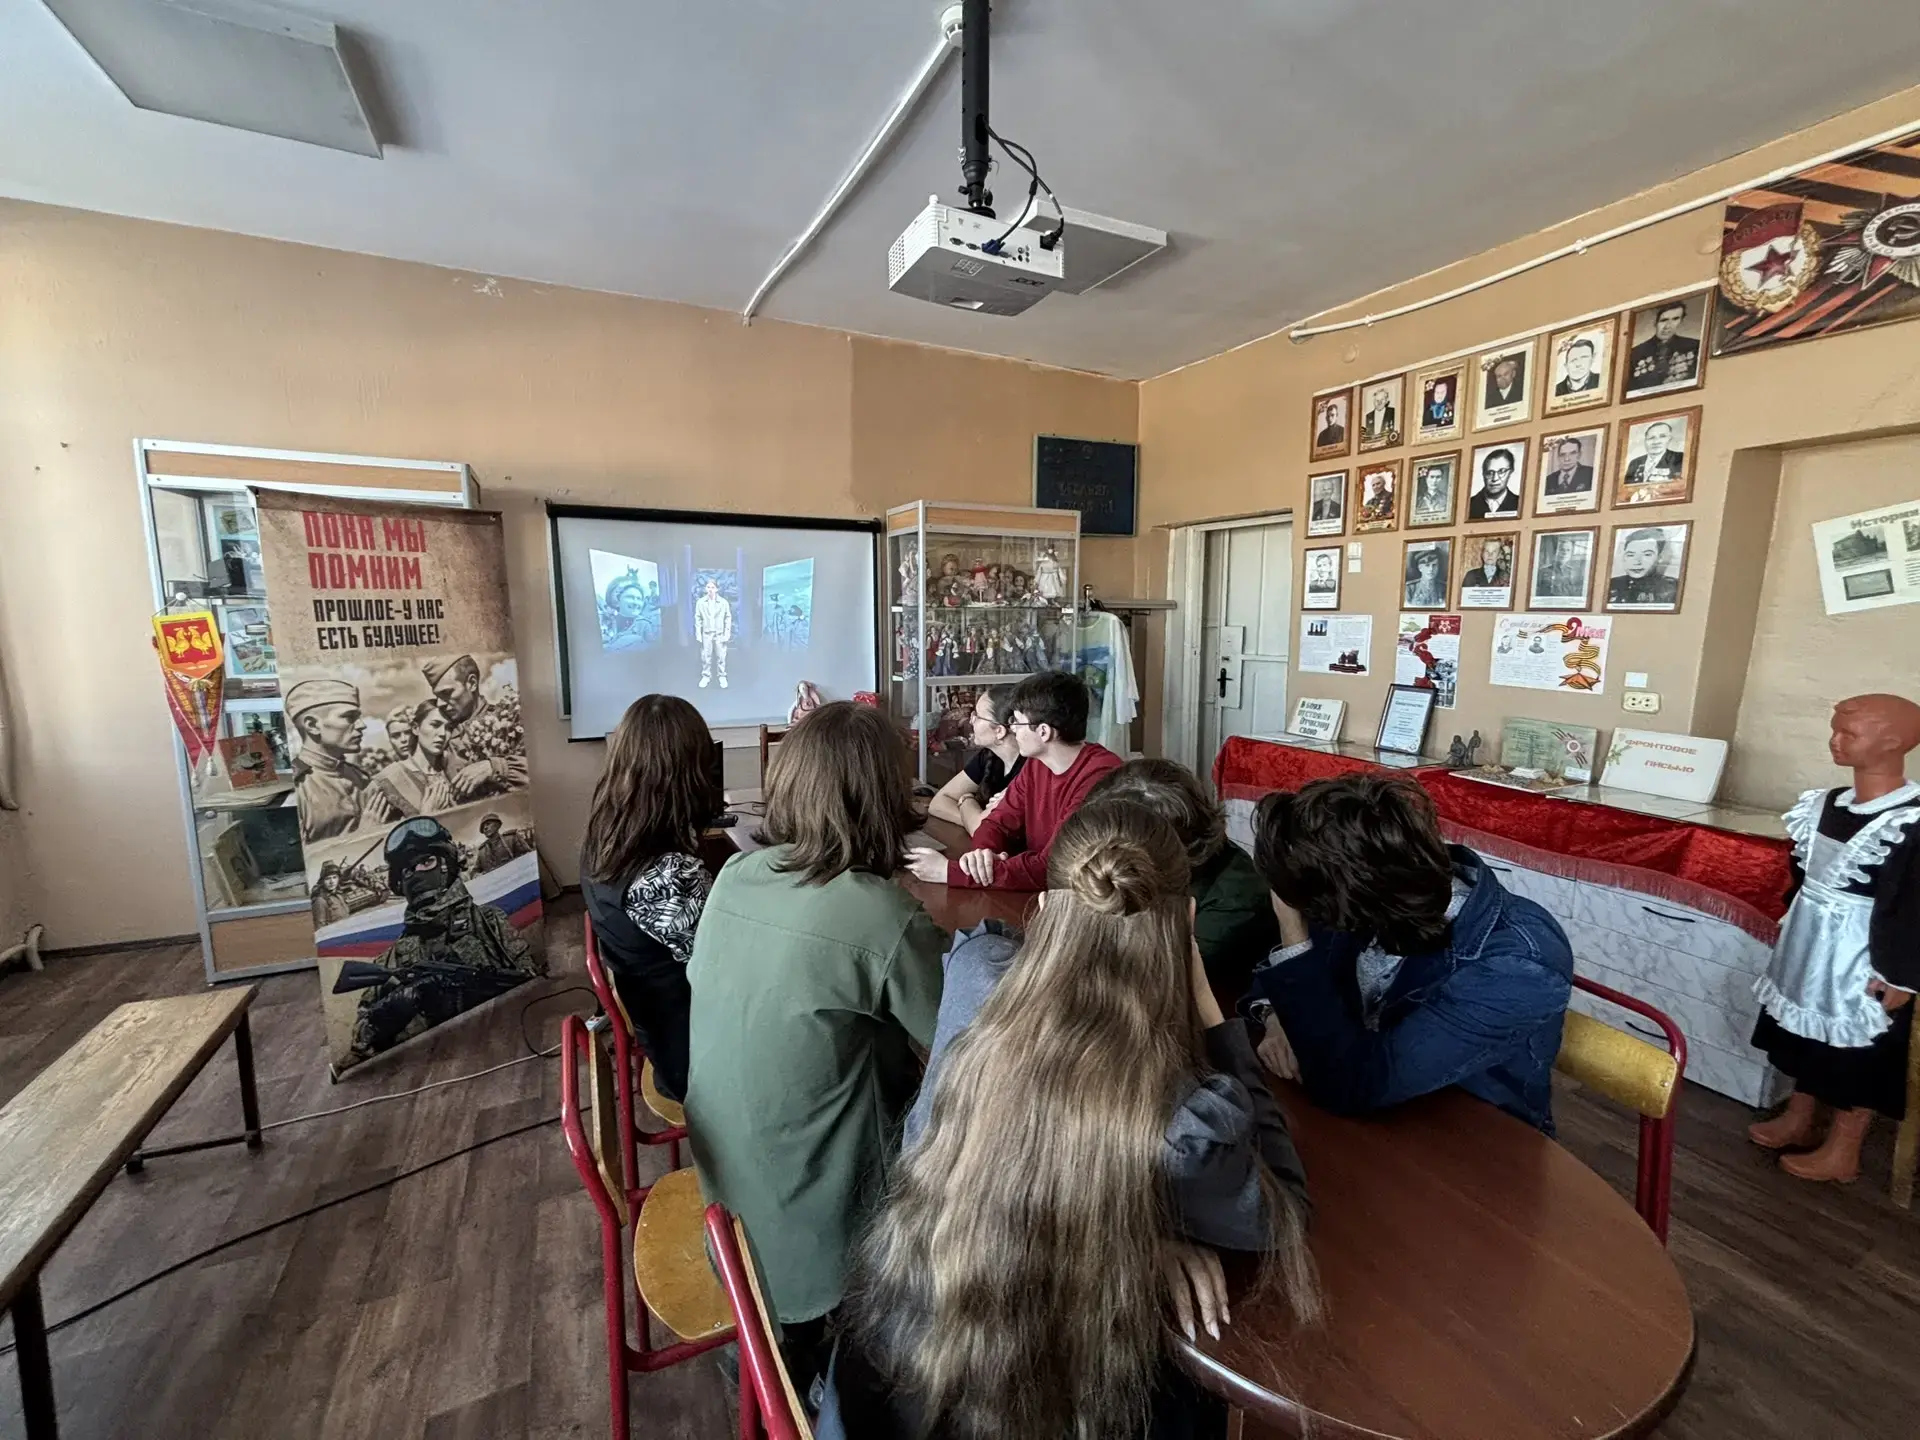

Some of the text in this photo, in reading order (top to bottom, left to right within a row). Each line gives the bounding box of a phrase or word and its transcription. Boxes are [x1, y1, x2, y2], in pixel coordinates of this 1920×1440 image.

[303, 511, 426, 552] ПОКА МЫ
[307, 552, 423, 590] ПОМНИМ
[416, 599, 445, 620] НАС
[316, 624, 440, 650] ЕСТЬ БУДУЩЕЕ!
[1625, 739, 1698, 755] ФРОНТОВОЕ
